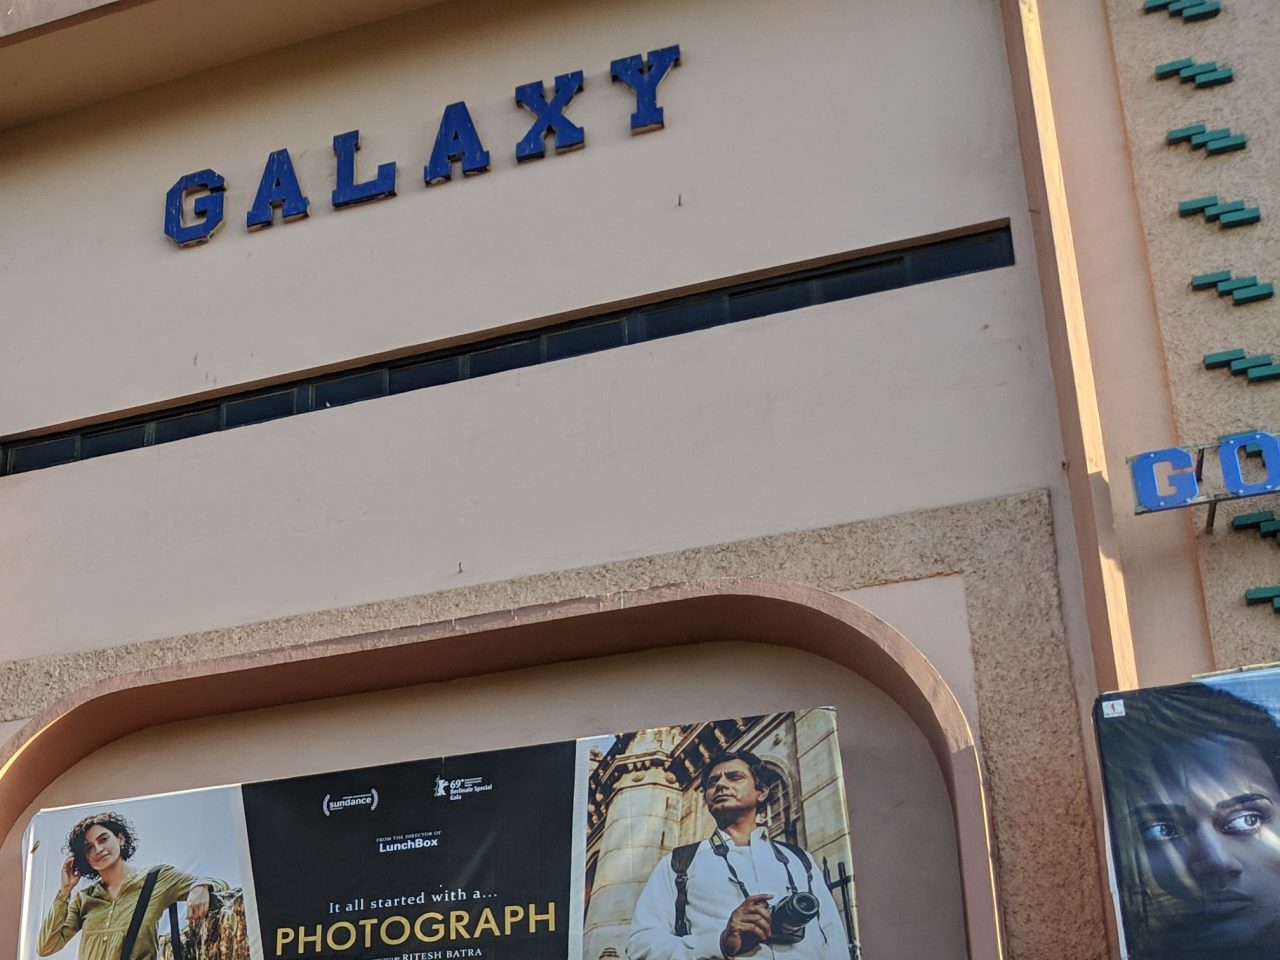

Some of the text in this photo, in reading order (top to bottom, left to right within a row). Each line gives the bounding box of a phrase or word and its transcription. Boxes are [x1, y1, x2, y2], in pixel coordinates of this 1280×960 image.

[164, 43, 681, 248] GALAXY
[329, 796, 371, 808] sundance
[379, 838, 438, 853] LunchBox
[329, 902, 340, 913] It
[345, 898, 364, 911] all
[370, 892, 425, 910] started
[431, 888, 466, 903] with
[276, 901, 556, 956] PHOTOGRAPH
[447, 948, 482, 958] BATRA
